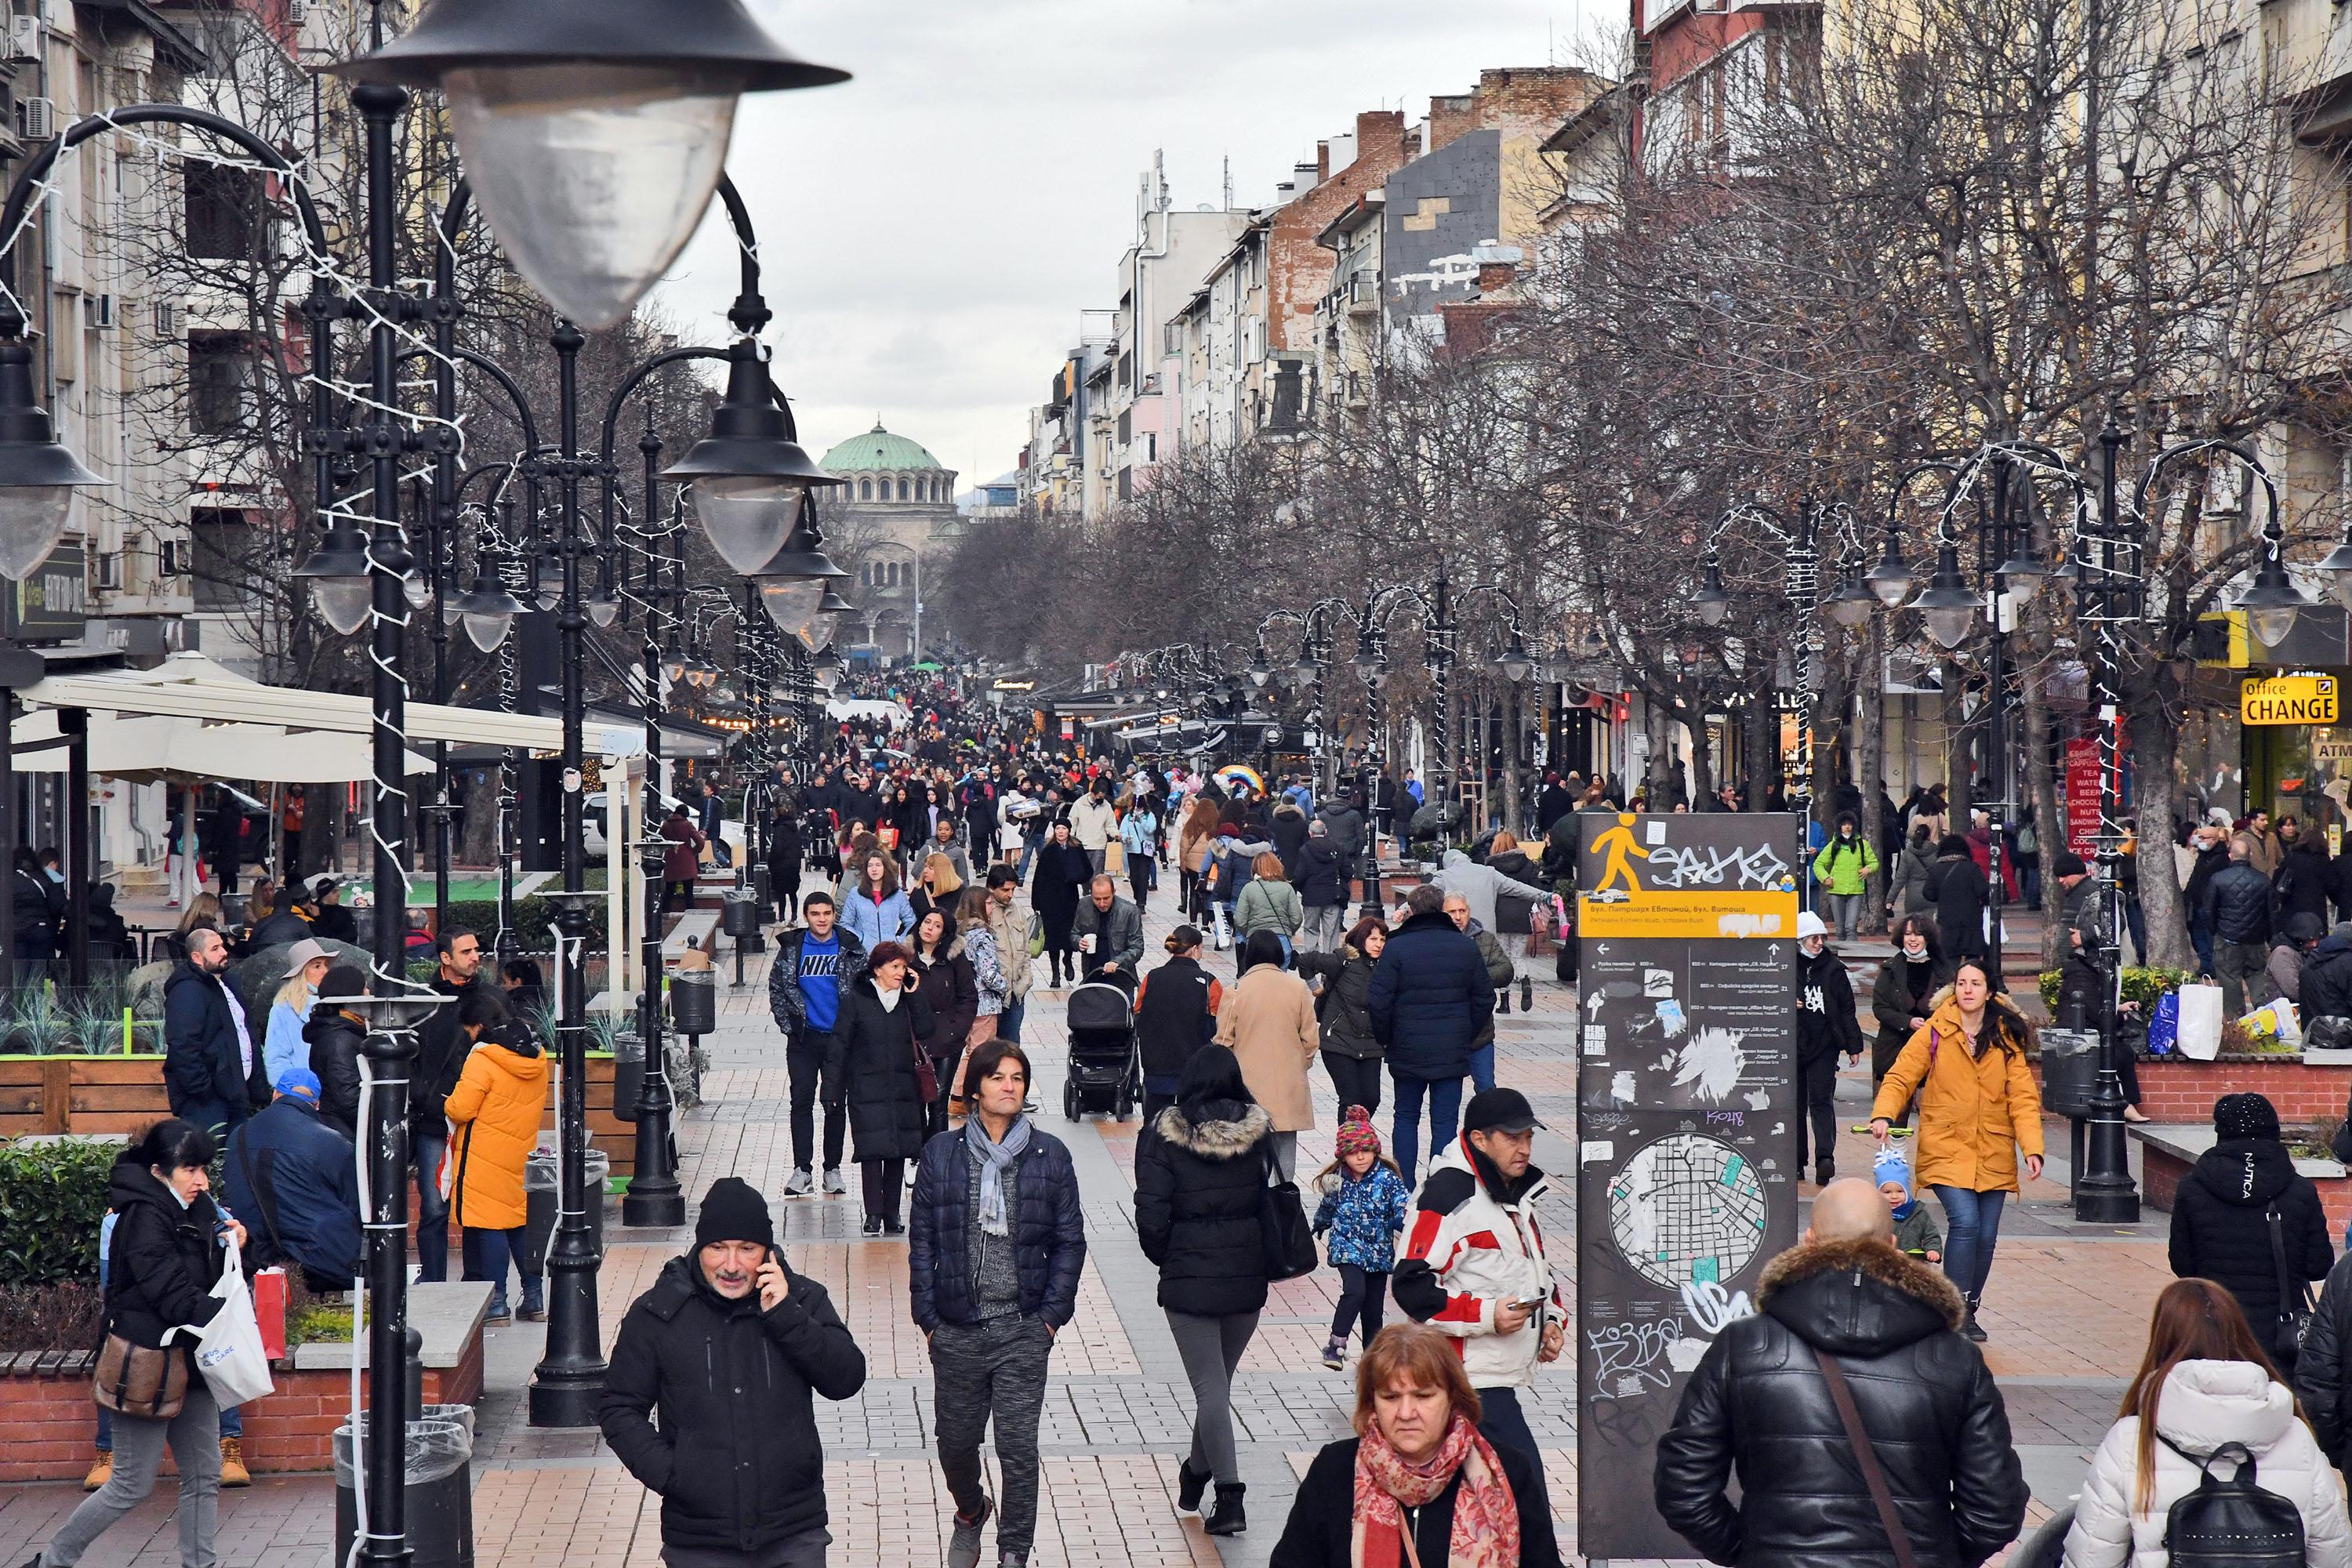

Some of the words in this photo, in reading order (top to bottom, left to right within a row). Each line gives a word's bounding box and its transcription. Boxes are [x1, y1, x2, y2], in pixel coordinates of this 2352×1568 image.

[2246, 681, 2286, 695] Office
[2247, 699, 2333, 720] CHANGE
[2318, 745, 2352, 757] ATM
[1590, 906, 1606, 914] бул.
[1652, 905, 1691, 913] Евтимий,
[1693, 906, 1709, 914] бул.
